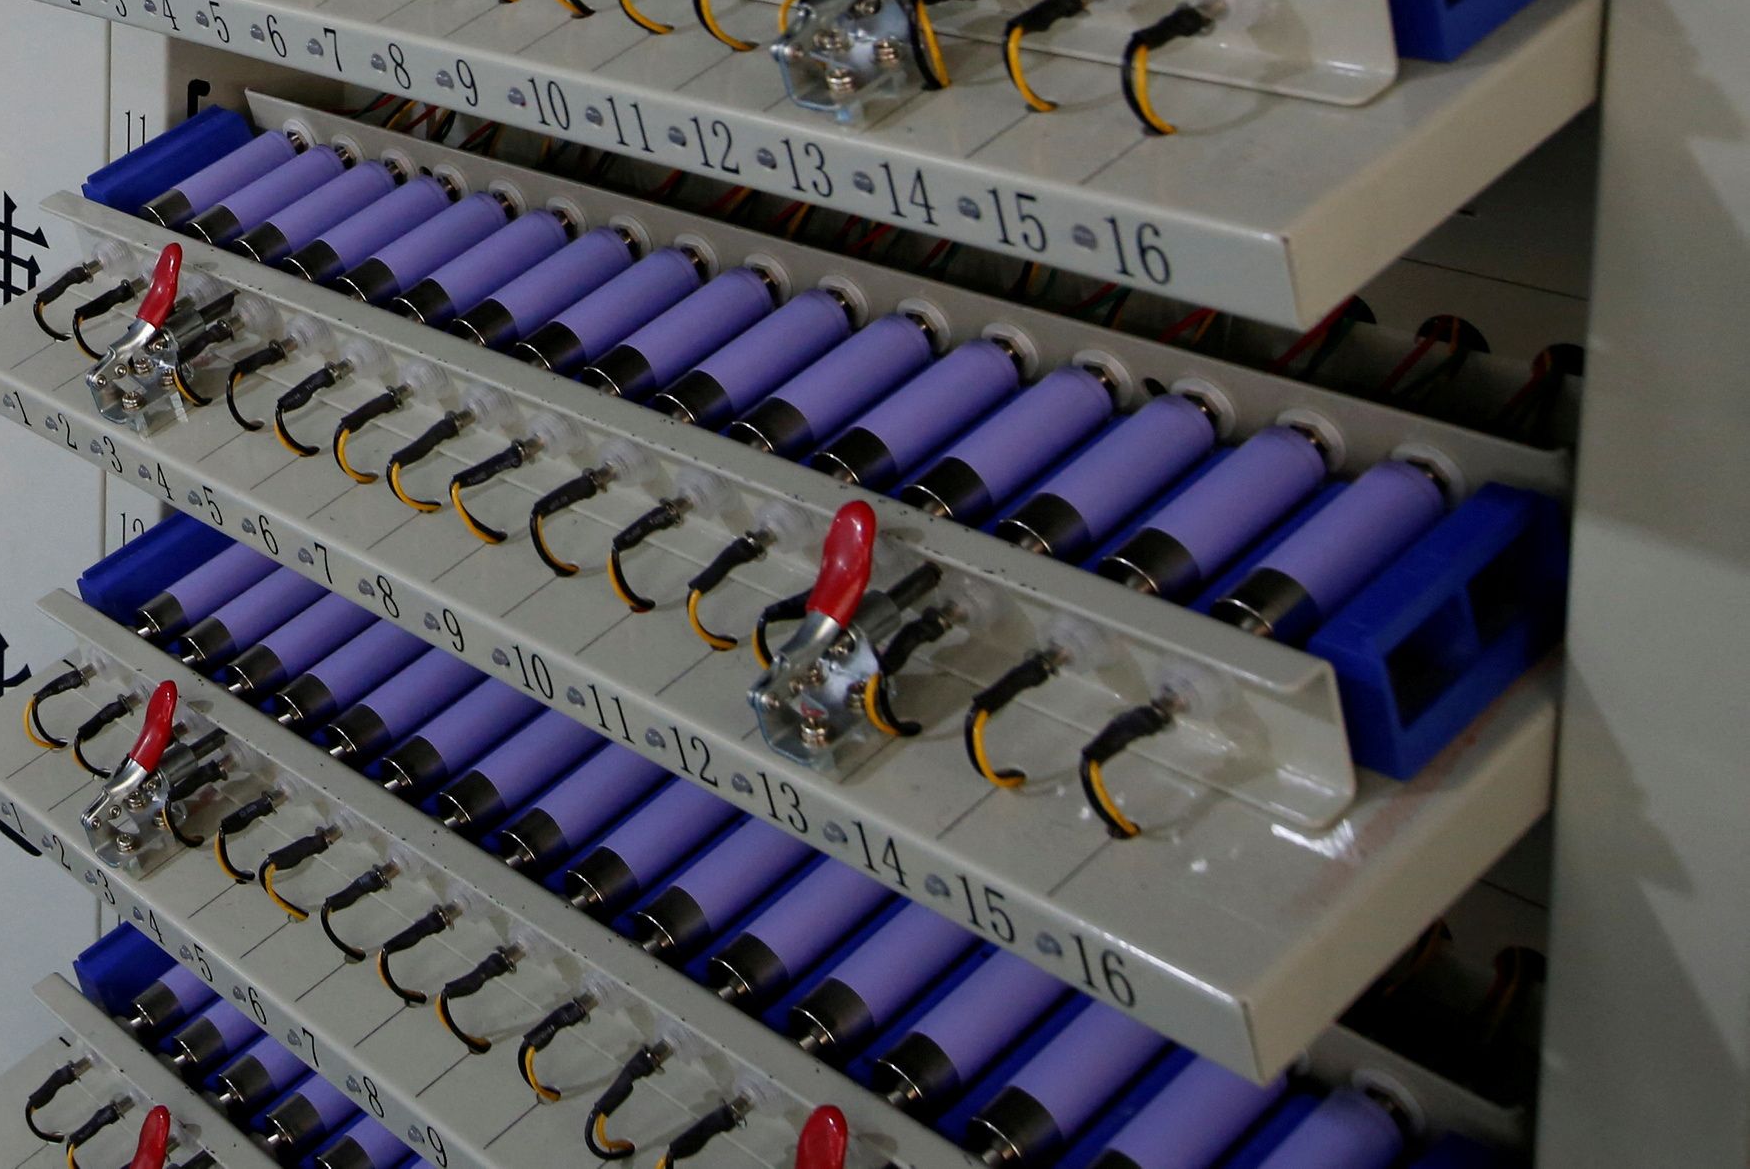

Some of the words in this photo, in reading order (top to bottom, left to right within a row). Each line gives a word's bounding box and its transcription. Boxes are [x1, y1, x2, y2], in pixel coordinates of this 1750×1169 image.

[125, 109, 147, 153] 11
[210, 0, 232, 44] 5
[266, 14, 289, 59] 6
[323, 28, 344, 74] 7
[389, 43, 413, 91] 8
[455, 59, 479, 108] 9
[528, 77, 572, 131] 10
[605, 96, 656, 155] 11
[690, 116, 741, 176] 12
[780, 138, 836, 200] 13
[878, 161, 940, 227] 14
[986, 186, 1049, 254] 15
[1104, 215, 1173, 286] 16
[12, 391, 33, 427] 1
[57, 413, 79, 450] 2
[103, 435, 124, 473] 3
[156, 462, 176, 501] 4
[201, 485, 224, 527] 5
[258, 514, 280, 555] 6
[314, 542, 333, 585] 7
[376, 574, 401, 619] 8
[442, 607, 465, 652] 9
[511, 644, 554, 700] 10
[585, 683, 637, 744] 11
[671, 726, 719, 788] 12
[758, 770, 810, 835] 13
[850, 820, 910, 890] 14
[954, 874, 1017, 943] 15
[1074, 934, 1138, 1009] 16
[11, 801, 27, 834] 1
[53, 833, 72, 873] 2
[96, 868, 116, 906] 3
[150, 909, 166, 947] 4
[194, 943, 213, 983] 5
[249, 986, 268, 1026] 6
[302, 1027, 322, 1069] 7
[362, 1075, 387, 1119] 8
[424, 1125, 448, 1169] 9
